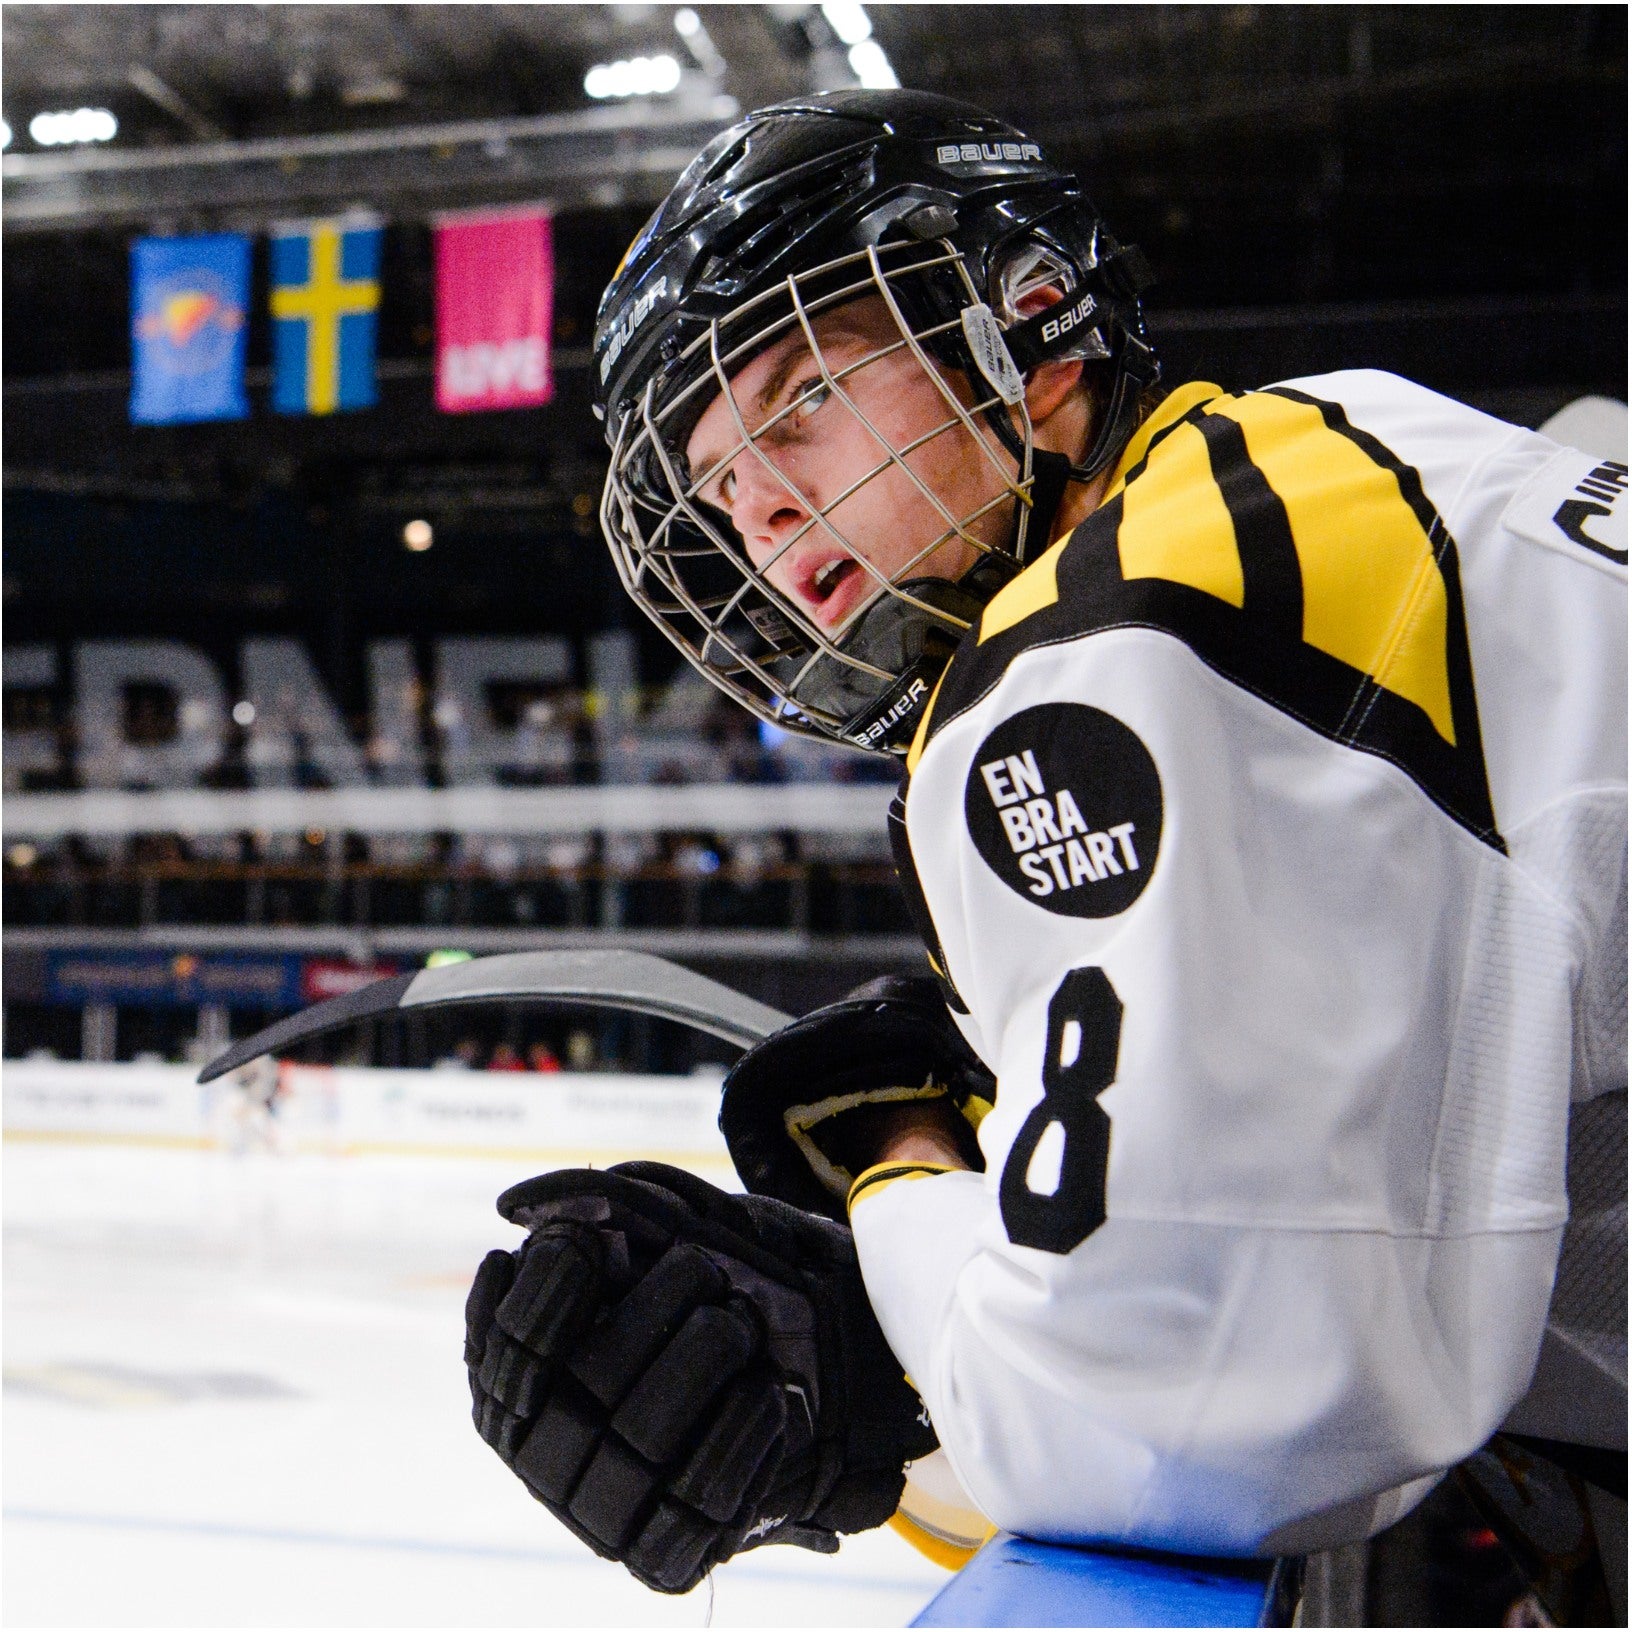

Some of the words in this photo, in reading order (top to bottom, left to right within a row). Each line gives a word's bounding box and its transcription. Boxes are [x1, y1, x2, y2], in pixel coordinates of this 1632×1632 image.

[936, 143, 1043, 164] BAUER
[600, 275, 667, 386] BAUER
[1041, 293, 1098, 343] BAUER
[854, 678, 929, 746] BAUER
[980, 749, 1045, 808] EN
[999, 789, 1089, 854] BRA
[1019, 822, 1140, 897] START
[999, 966, 1124, 1255] 8
